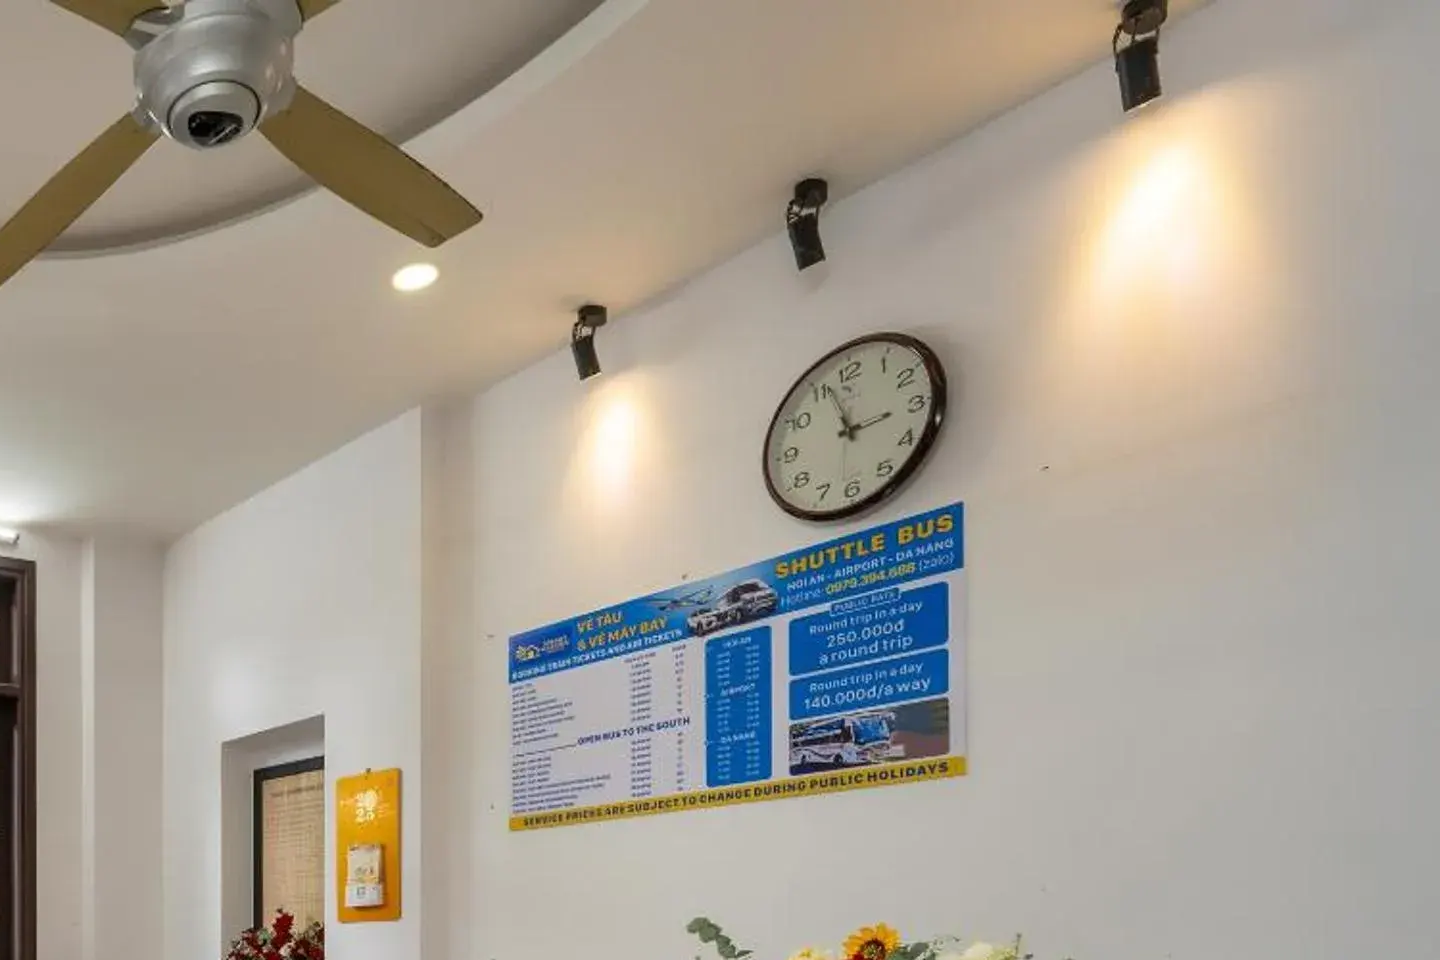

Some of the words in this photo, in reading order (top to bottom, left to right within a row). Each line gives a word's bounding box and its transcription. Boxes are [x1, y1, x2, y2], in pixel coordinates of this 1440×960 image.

[839, 362, 862, 383] 12
[897, 368, 915, 389] 2
[908, 395, 926, 414] 3
[786, 412, 811, 430] 10
[898, 429, 914, 446] 4
[784, 447, 799, 463] 9
[877, 460, 893, 477] 5
[794, 472, 810, 488] 8
[816, 483, 831, 500] 7
[845, 482, 860, 498] 6
[775, 534, 885, 579] SHUTTLE
[898, 515, 953, 545] BUS
[835, 556, 887, 578] AIRPORT
[809, 619, 848, 635] Round
[850, 613, 873, 627] trip
[899, 602, 923, 614] day
[882, 634, 914, 651] trip
[809, 677, 848, 693] Round
[850, 671, 873, 686] trip
[899, 662, 924, 676] day
[896, 677, 931, 693] way
[656, 716, 690, 731] SOUTH
[626, 798, 679, 814] SUBJECT
[681, 795, 696, 807] TO
[699, 787, 752, 804] CHANGE
[753, 780, 806, 797] DURING
[809, 773, 864, 790] PUBLIC
[866, 761, 949, 783] HOLIDAYS
